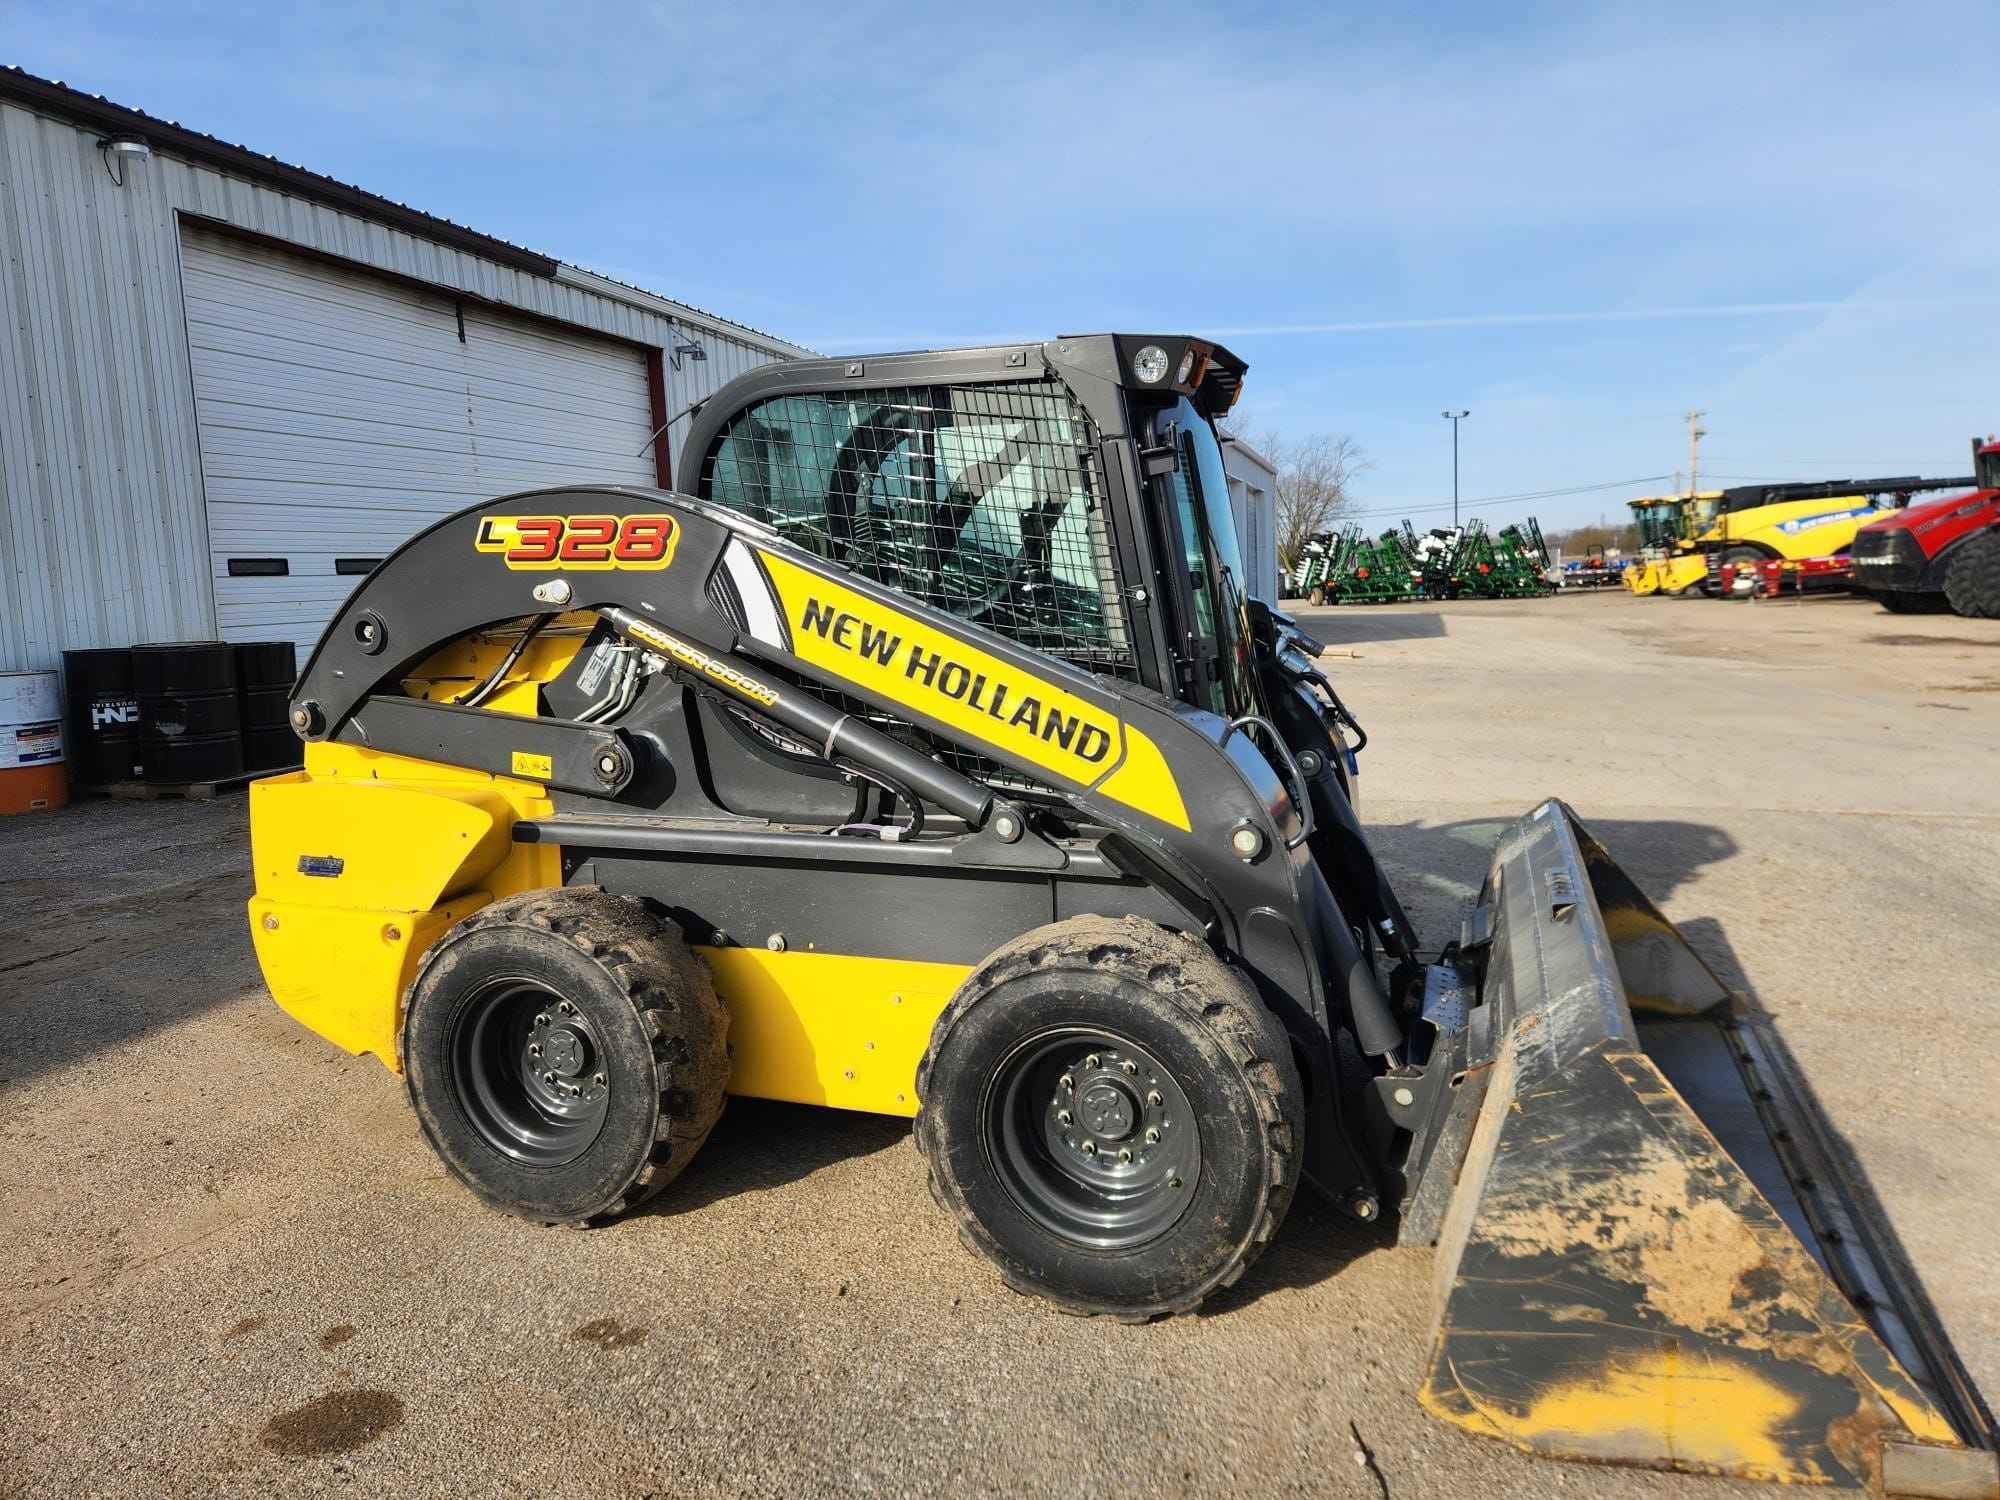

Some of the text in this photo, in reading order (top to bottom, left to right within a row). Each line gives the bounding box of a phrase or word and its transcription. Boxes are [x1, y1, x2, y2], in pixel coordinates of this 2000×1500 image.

[478, 517, 674, 564] L328
[628, 620, 708, 669] SUPER
[704, 659, 779, 706] BOOM
[800, 597, 1112, 763] NEW HOLLAND
